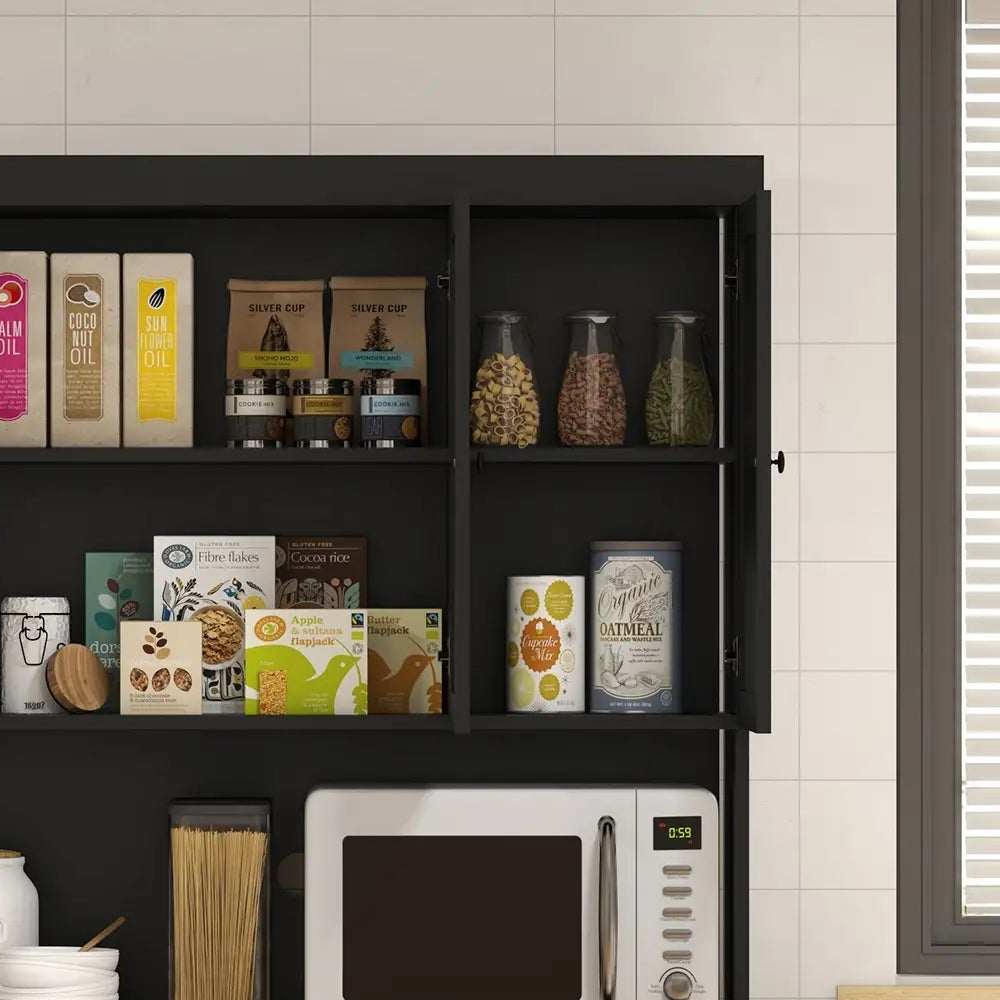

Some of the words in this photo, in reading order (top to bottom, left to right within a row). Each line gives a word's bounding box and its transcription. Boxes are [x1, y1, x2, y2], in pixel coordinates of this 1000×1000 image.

[249, 304, 282, 313] SILVER
[285, 304, 305, 313] CUP
[351, 304, 384, 313] SILVER
[387, 304, 407, 313] CUP
[69, 312, 97, 330] COCO
[145, 316, 167, 332] SUN
[72, 330, 93, 347] NUT
[70, 348, 96, 365] OIL
[144, 351, 169, 367] OIL
[199, 551, 226, 562] Fibre
[228, 551, 260, 562] flakes
[291, 552, 326, 562] Cocoa
[330, 552, 350, 562] rice
[598, 572, 661, 620] Organic
[291, 616, 323, 626] Apple
[367, 615, 401, 624] Butter
[302, 626, 344, 635] sultana
[600, 622, 663, 636] OATMEAL
[291, 637, 335, 647] flapjack
[522, 635, 558, 650] Cupcake
[534, 648, 554, 661] Mix
[668, 827, 692, 839] 0:59
